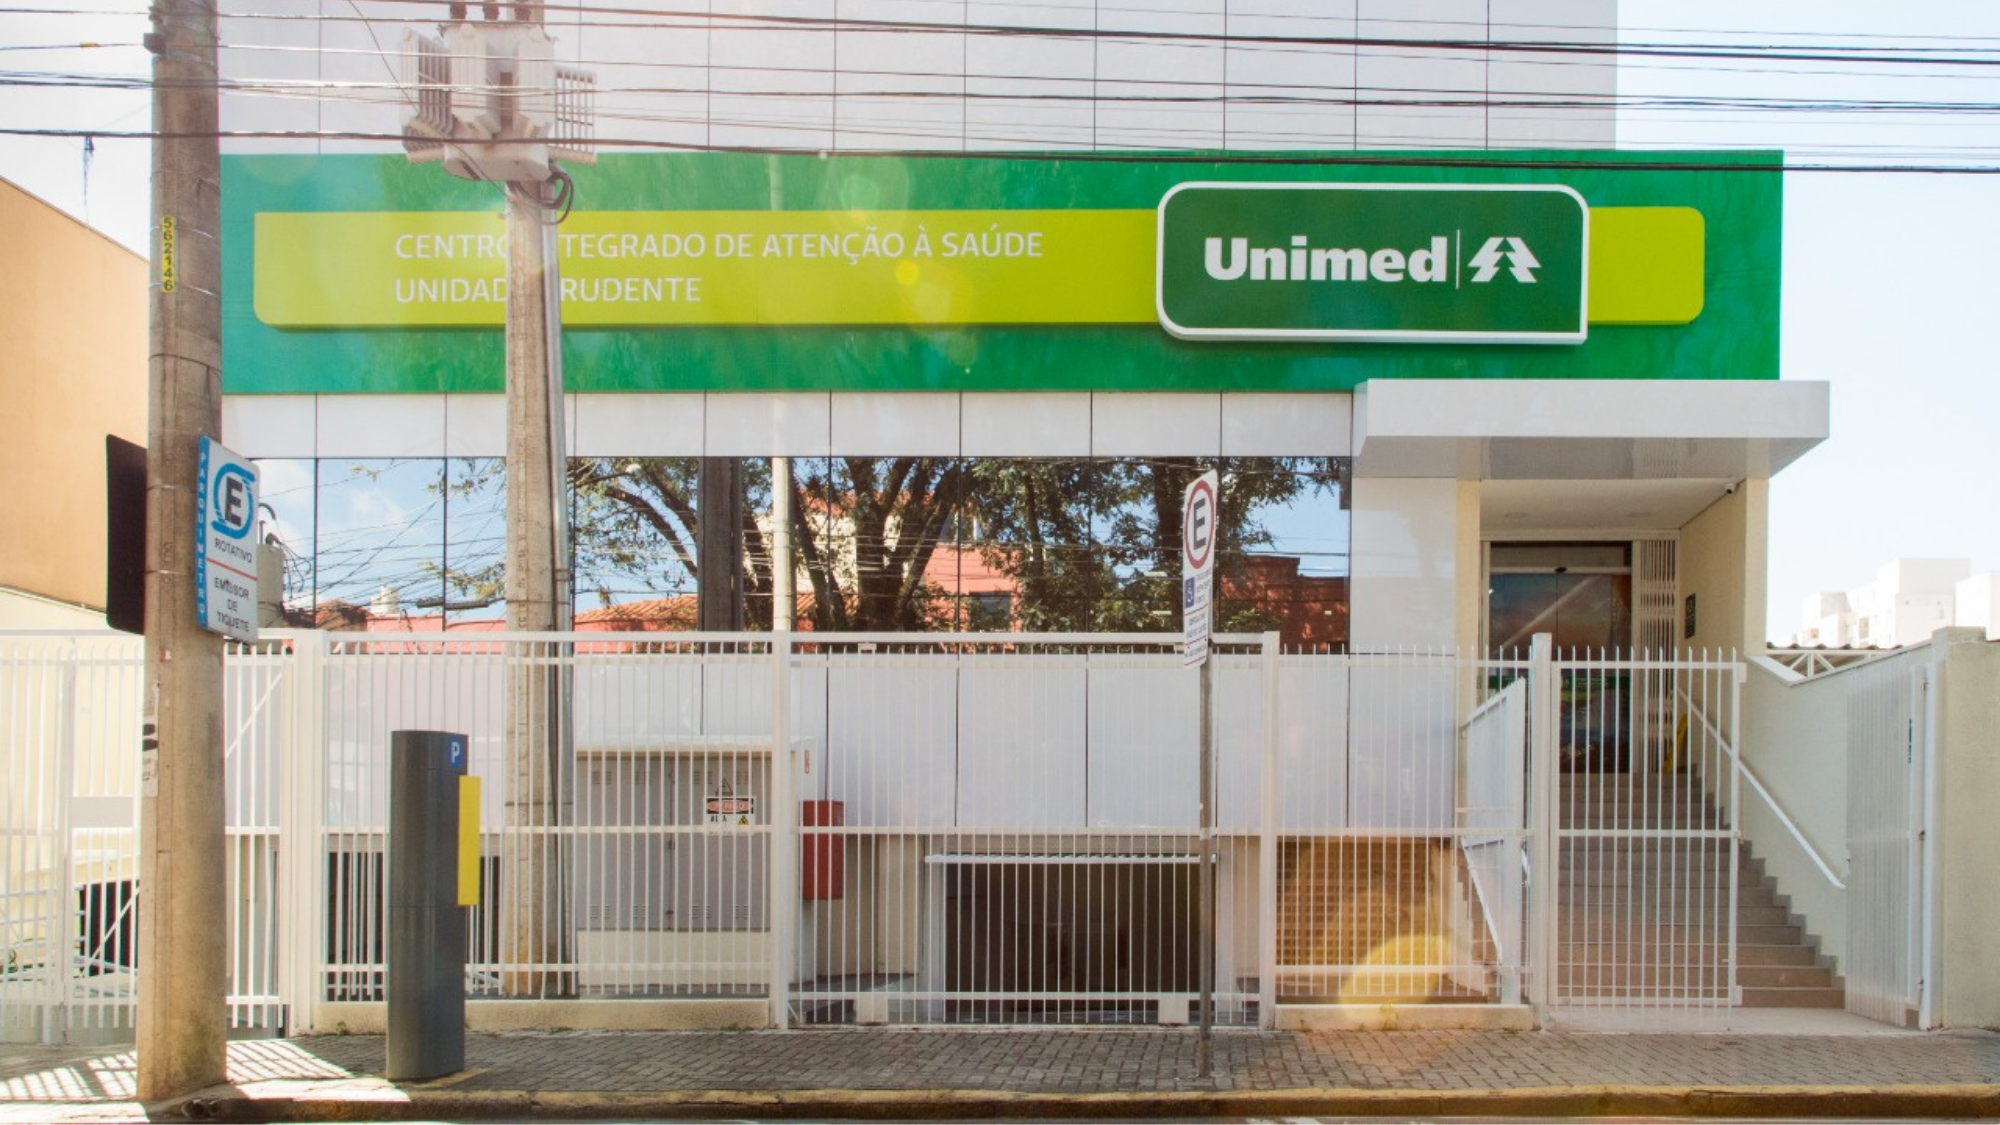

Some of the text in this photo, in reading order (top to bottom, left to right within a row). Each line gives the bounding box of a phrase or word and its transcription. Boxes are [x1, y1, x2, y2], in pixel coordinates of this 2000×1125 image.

[163, 217, 173, 291] 562146
[558, 233, 706, 258] TEGRADO
[714, 233, 753, 258] DE
[762, 226, 905, 265] ATENÇÃO
[912, 224, 933, 258] À
[941, 223, 1043, 258] SAÚDE
[1204, 235, 1448, 282] Unimed
[395, 277, 701, 303] UNIDAD RUDENTE
[225, 476, 243, 527] E
[1193, 498, 1206, 550] E
[214, 537, 253, 563] ROTATIVO
[214, 577, 250, 600] EMISSOR
[227, 598, 238, 612] DE
[217, 611, 250, 632] TIQUETE
[452, 742, 460, 763] P
